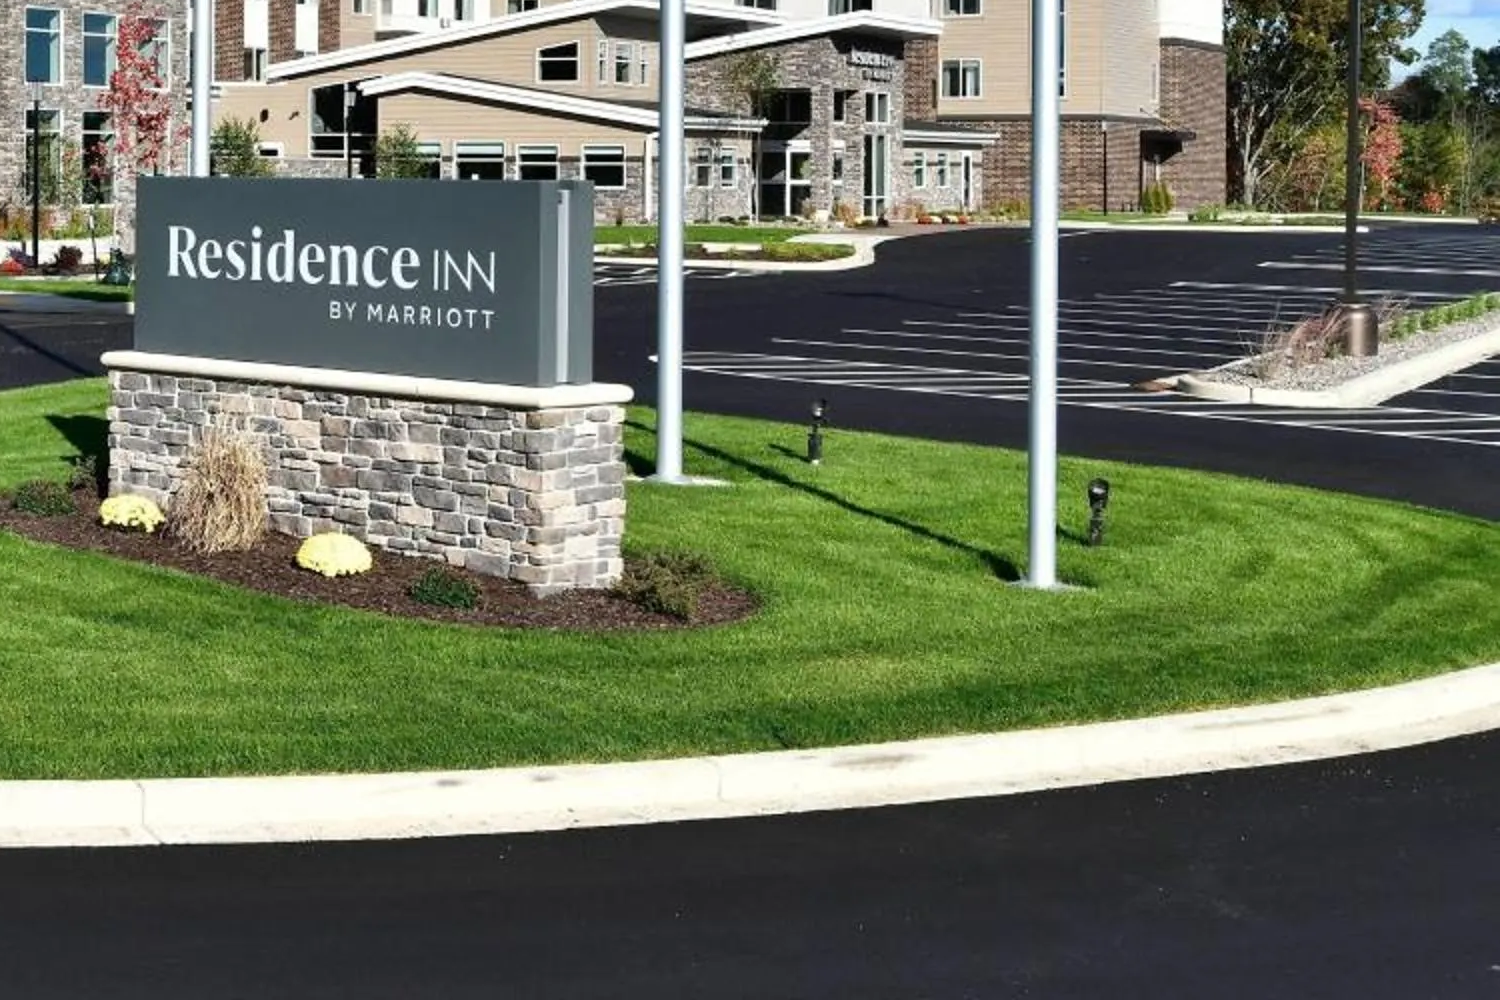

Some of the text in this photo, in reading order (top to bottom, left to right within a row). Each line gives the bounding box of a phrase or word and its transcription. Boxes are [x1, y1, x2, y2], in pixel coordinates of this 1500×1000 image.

[167, 225, 496, 294] Residence INN
[329, 301, 495, 329] BY MARRIOTT
